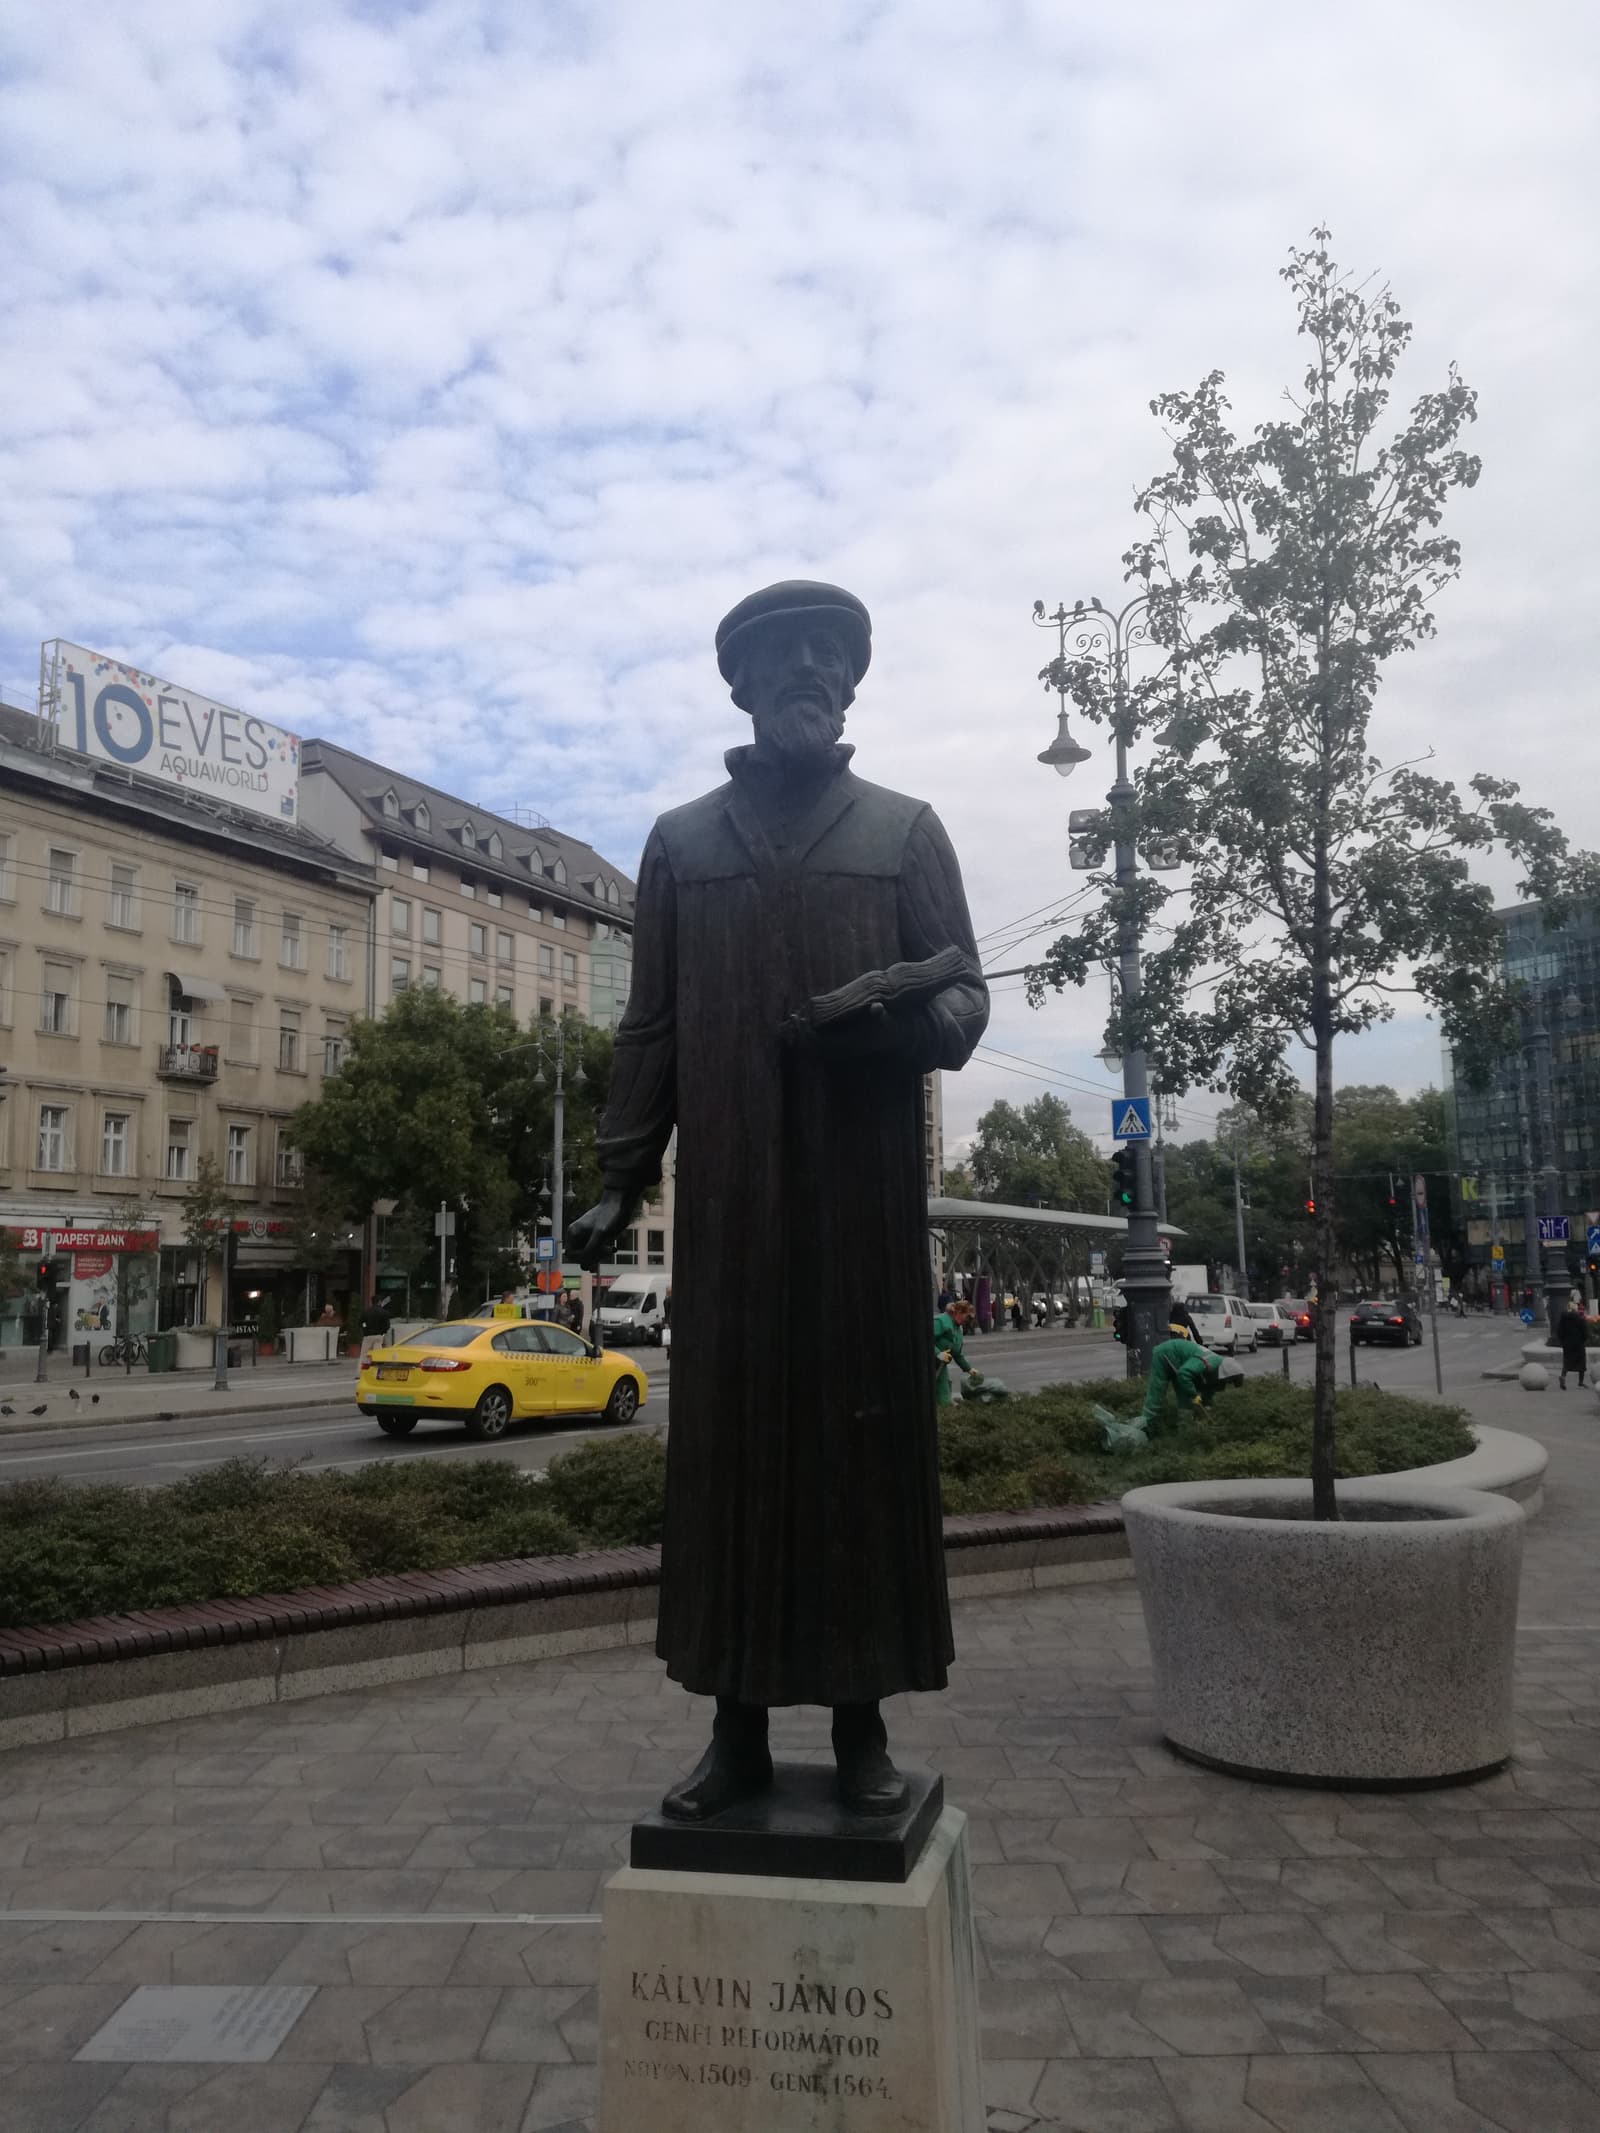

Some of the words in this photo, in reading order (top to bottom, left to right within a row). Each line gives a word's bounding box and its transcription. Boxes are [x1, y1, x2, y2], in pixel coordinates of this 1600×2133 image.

[66, 671, 154, 764] 10
[158, 685, 269, 771] ÉVES
[159, 752, 270, 794] AQUAWORLD
[41, 1231, 96, 1246] DAPEST
[97, 1234, 126, 1247] BANK
[631, 1963, 753, 2009] KÁLVIN
[769, 1974, 894, 2020] JÁNOS
[645, 2020, 713, 2046] GENFI
[721, 2027, 881, 2058] REFORMÁTOR
